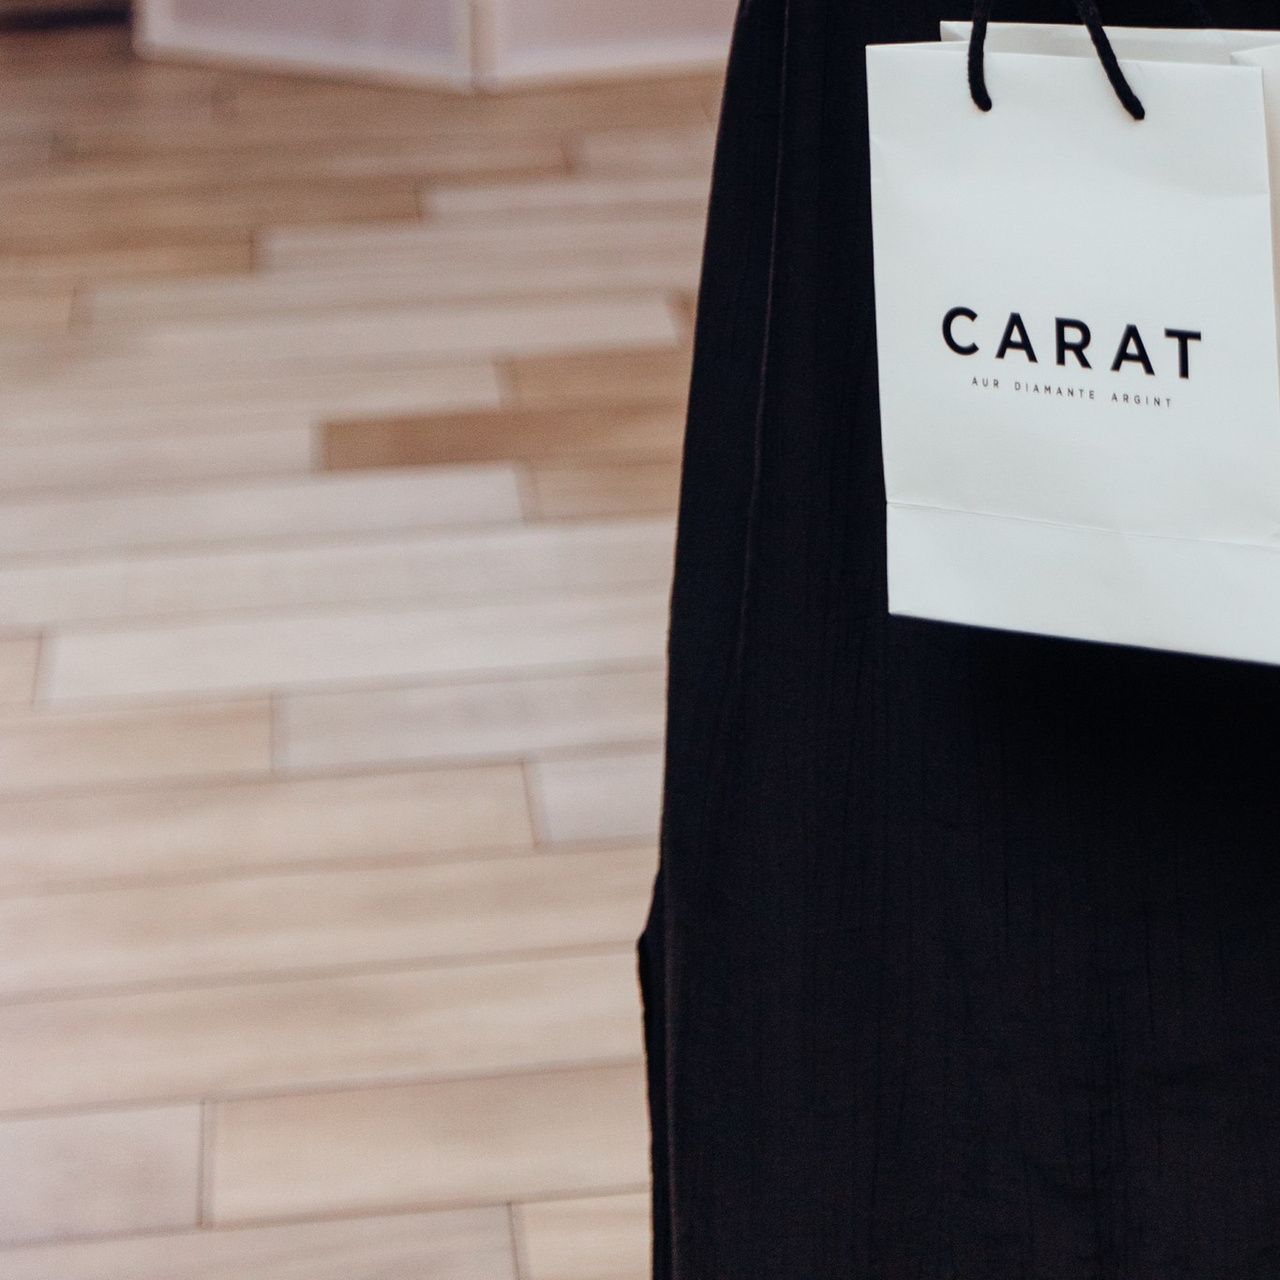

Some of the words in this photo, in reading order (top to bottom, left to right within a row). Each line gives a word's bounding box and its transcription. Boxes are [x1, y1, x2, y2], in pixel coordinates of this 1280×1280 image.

[942, 306, 1201, 379] CARAT
[971, 376, 1000, 389] AUR
[1014, 381, 1095, 400] DIAMANTE
[1111, 393, 1172, 408] ARGINT
